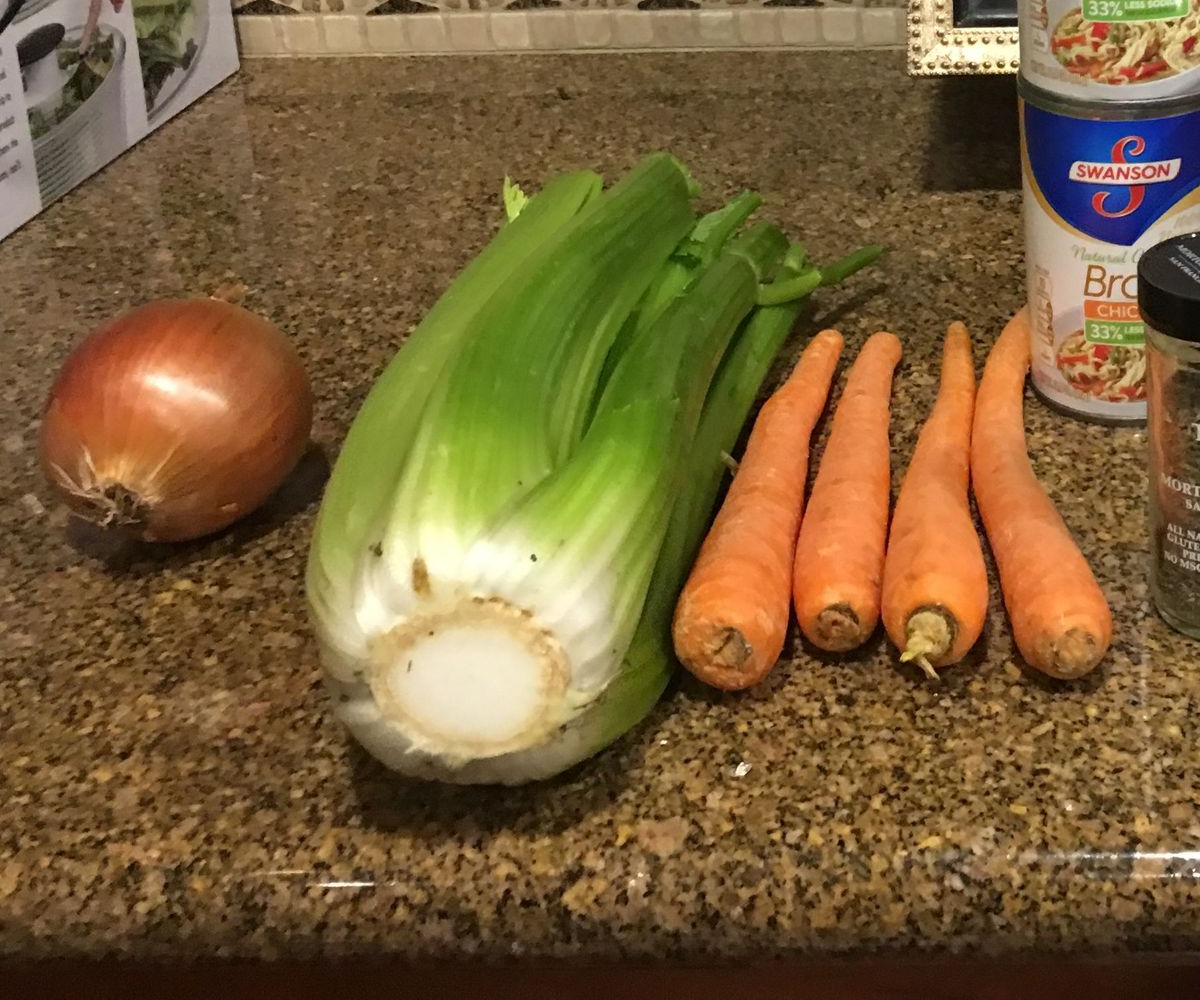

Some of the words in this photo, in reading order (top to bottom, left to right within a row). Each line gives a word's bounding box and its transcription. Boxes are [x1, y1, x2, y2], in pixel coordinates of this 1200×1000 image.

[1088, 0, 1123, 16] 33%
[1124, 0, 1145, 9] LESS
[1076, 163, 1171, 180] SWANSON
[1071, 244, 1127, 264] Natural
[1083, 264, 1139, 299] Bro
[1097, 304, 1139, 318] CHIC
[1090, 324, 1124, 340] 33%
[1167, 522, 1185, 536] ALL
[1164, 551, 1179, 564] NO
